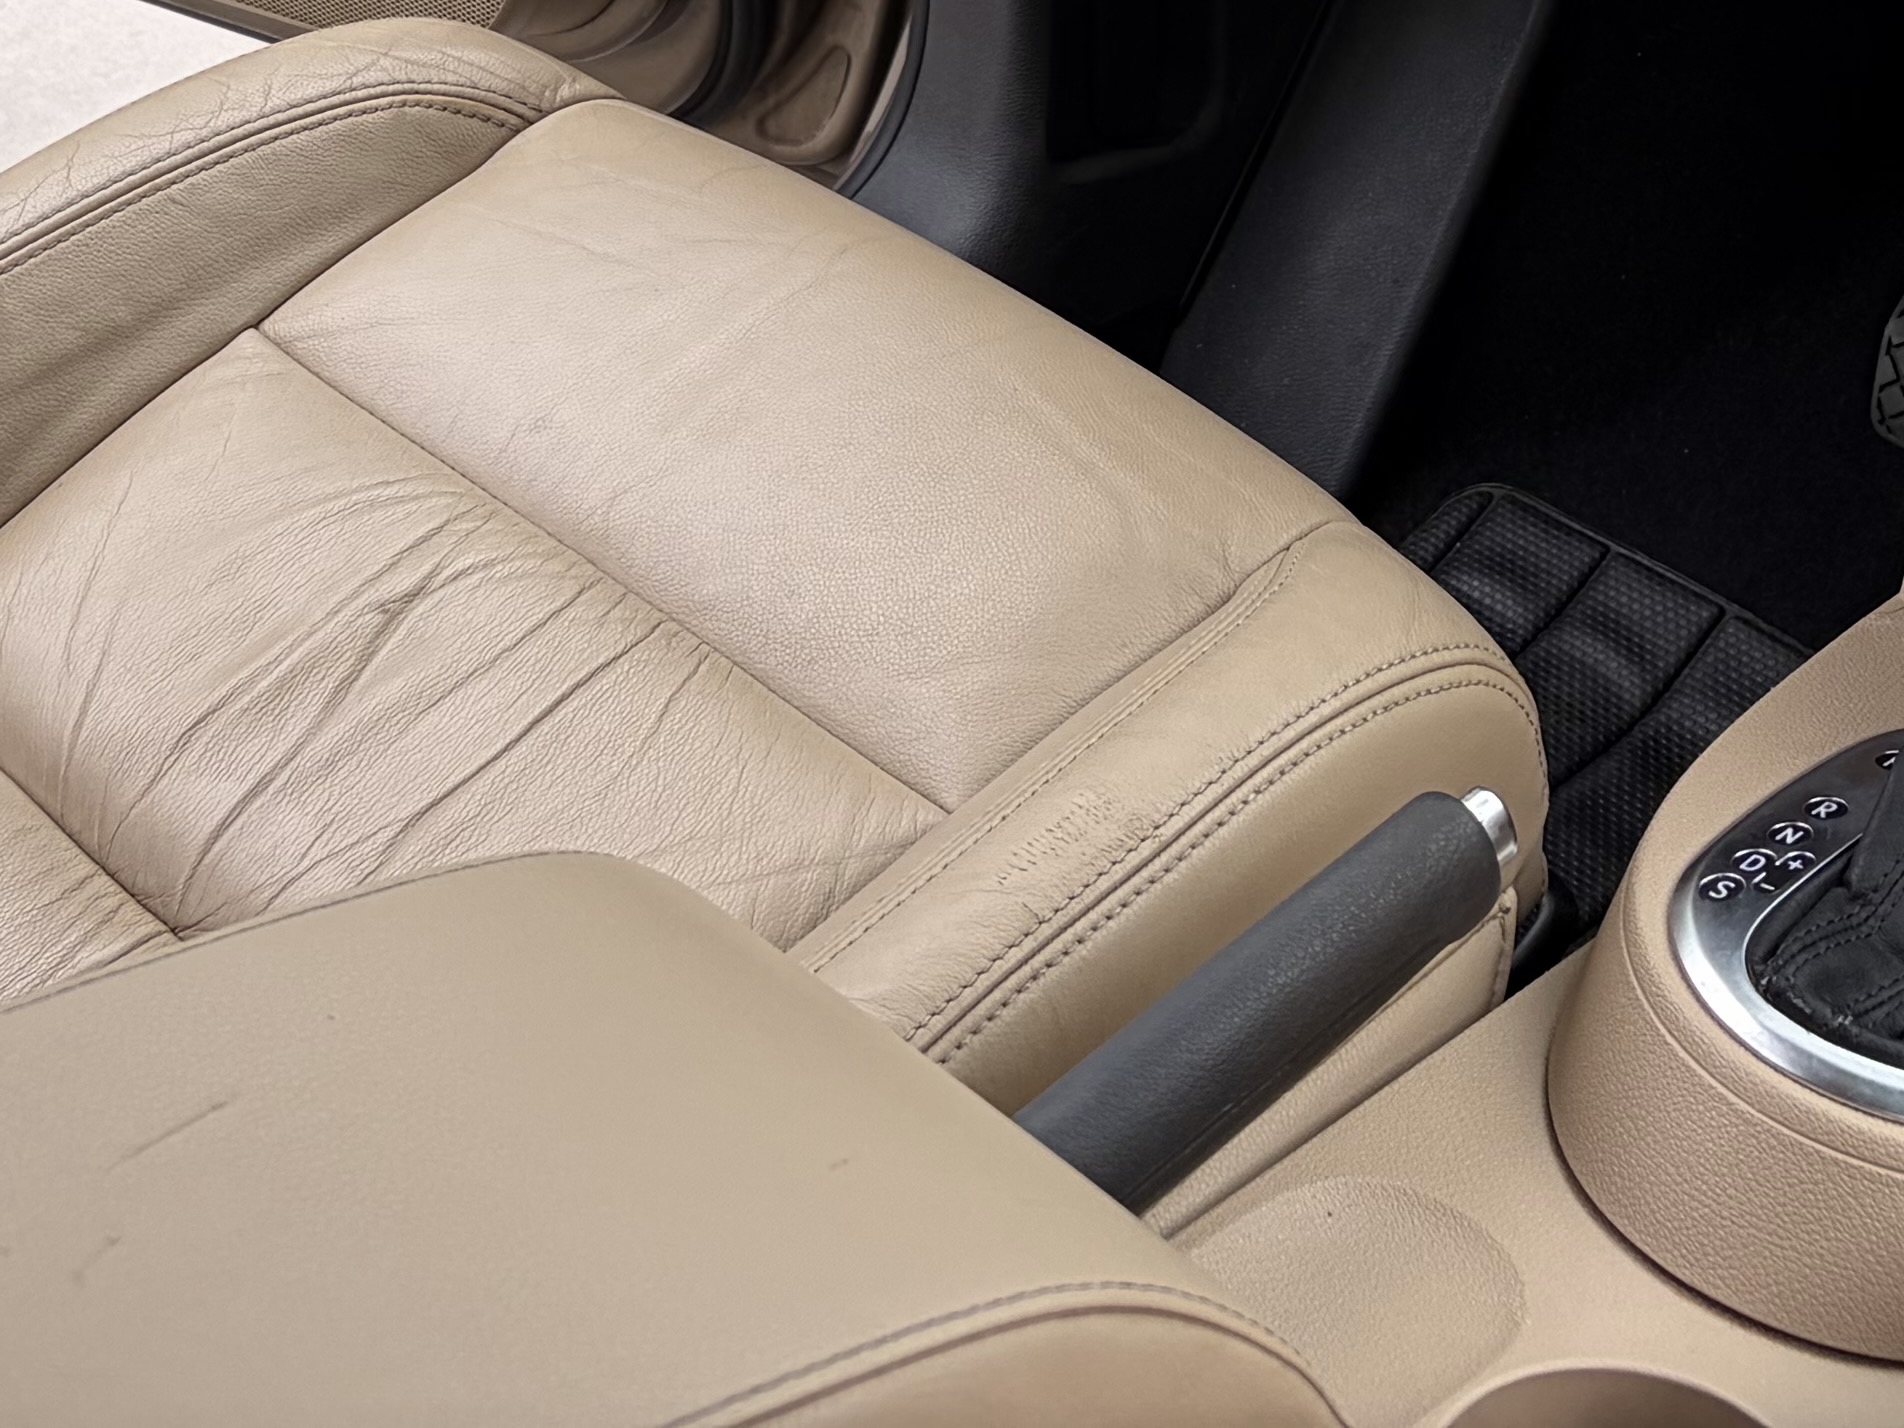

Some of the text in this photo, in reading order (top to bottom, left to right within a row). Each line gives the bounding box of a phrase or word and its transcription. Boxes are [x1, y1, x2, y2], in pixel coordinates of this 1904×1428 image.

[1810, 801, 1838, 819] R
[1774, 827, 1804, 844] N
[1739, 854, 1767, 871] D
[1708, 880, 1736, 899] S
